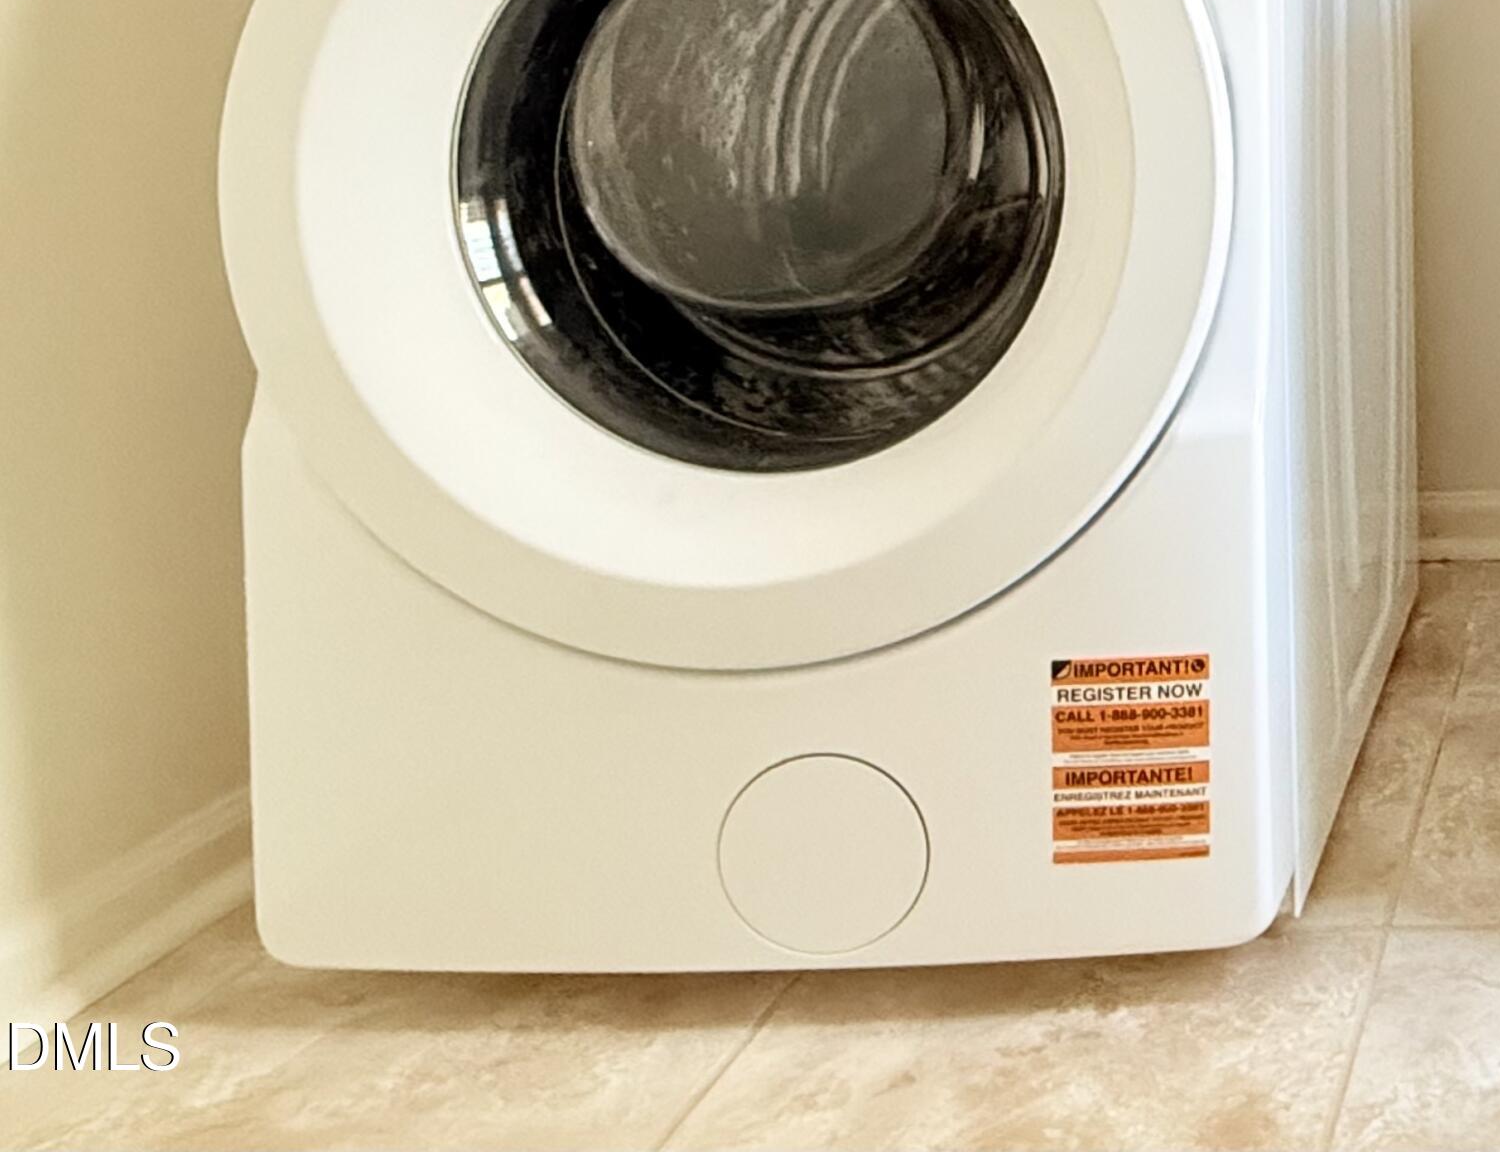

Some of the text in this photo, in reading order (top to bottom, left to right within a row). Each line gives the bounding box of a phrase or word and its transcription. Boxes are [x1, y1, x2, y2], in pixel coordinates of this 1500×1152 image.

[1073, 659, 1189, 678] IMPORTANT!
[1057, 683, 1203, 703] REGISTER NOW
[1055, 706, 1203, 723] CALL 1-888-900-3381
[1065, 767, 1192, 786] IMPORTANTE!
[1053, 787, 1207, 802] ENREGISTREZ MAINTENANT
